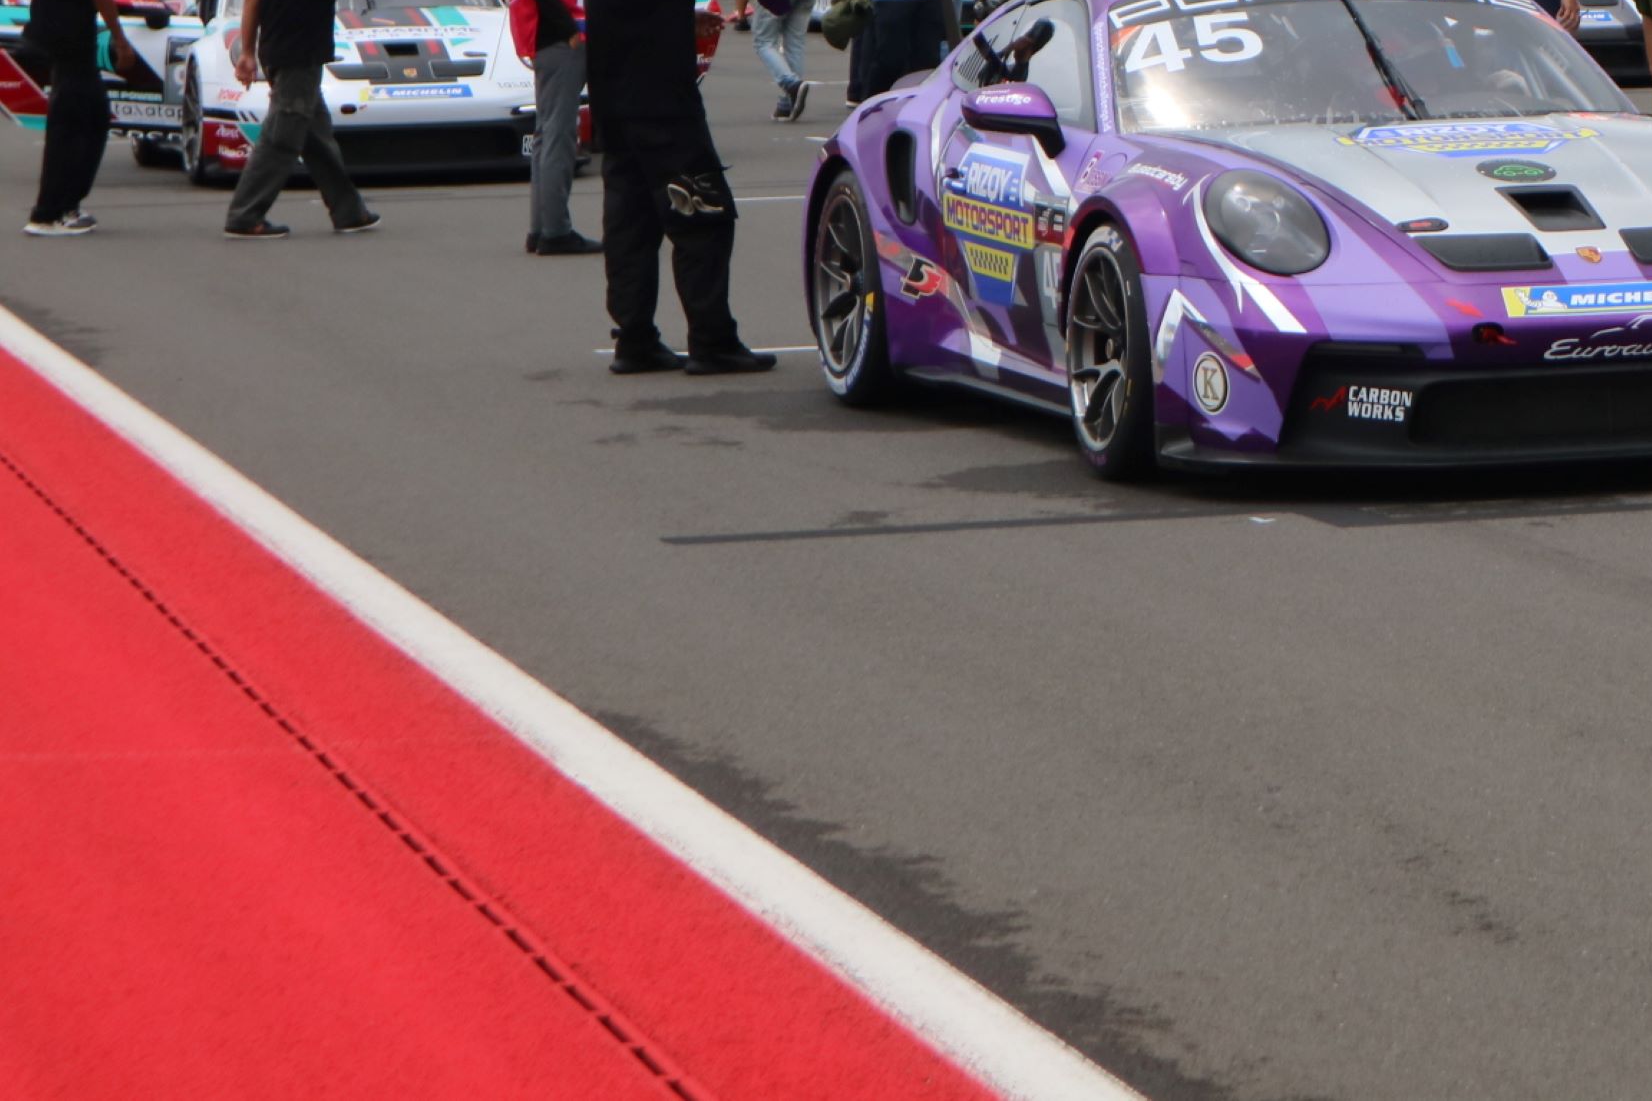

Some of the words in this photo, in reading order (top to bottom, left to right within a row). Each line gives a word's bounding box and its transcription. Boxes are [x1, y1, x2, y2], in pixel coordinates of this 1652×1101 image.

[1125, 11, 1264, 73] 45
[392, 87, 463, 96] MICHELIN
[976, 92, 1032, 106] Prestige
[966, 161, 1013, 203] RIZQY
[947, 198, 1029, 245] MOTORSPORT
[1201, 366, 1219, 401] K
[1348, 385, 1413, 407] CARBON
[1347, 401, 1406, 422] WORKS
